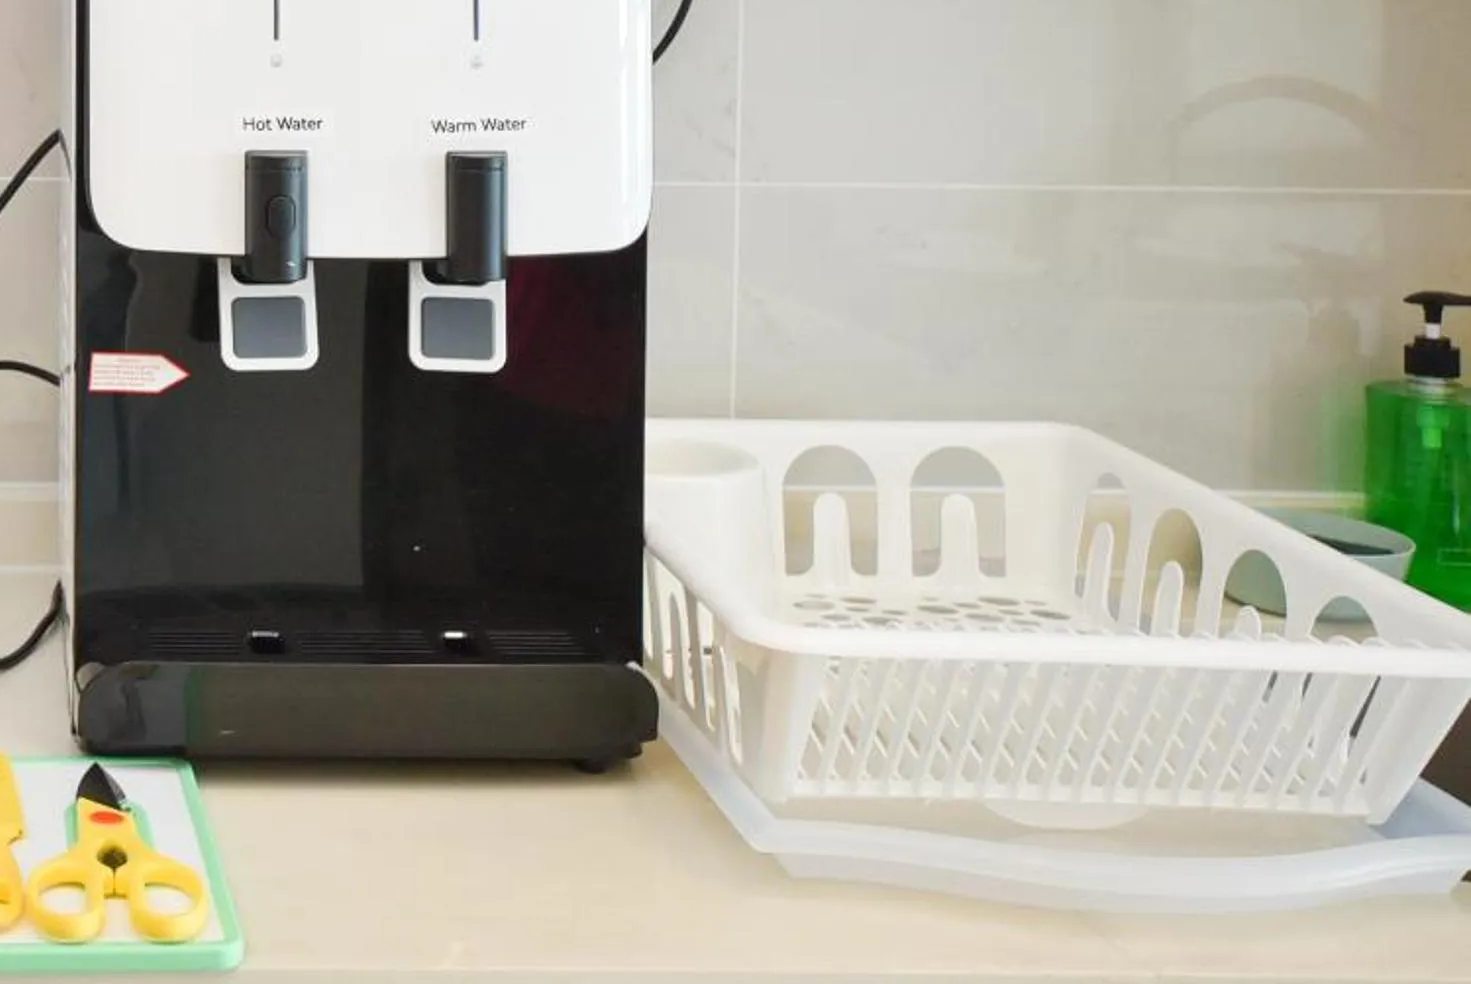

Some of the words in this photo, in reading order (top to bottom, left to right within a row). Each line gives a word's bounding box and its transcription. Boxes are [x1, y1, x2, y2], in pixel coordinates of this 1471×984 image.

[242, 116, 273, 131] Hot
[275, 116, 324, 132] Water
[430, 118, 477, 134] Warm
[479, 117, 527, 132] Water
